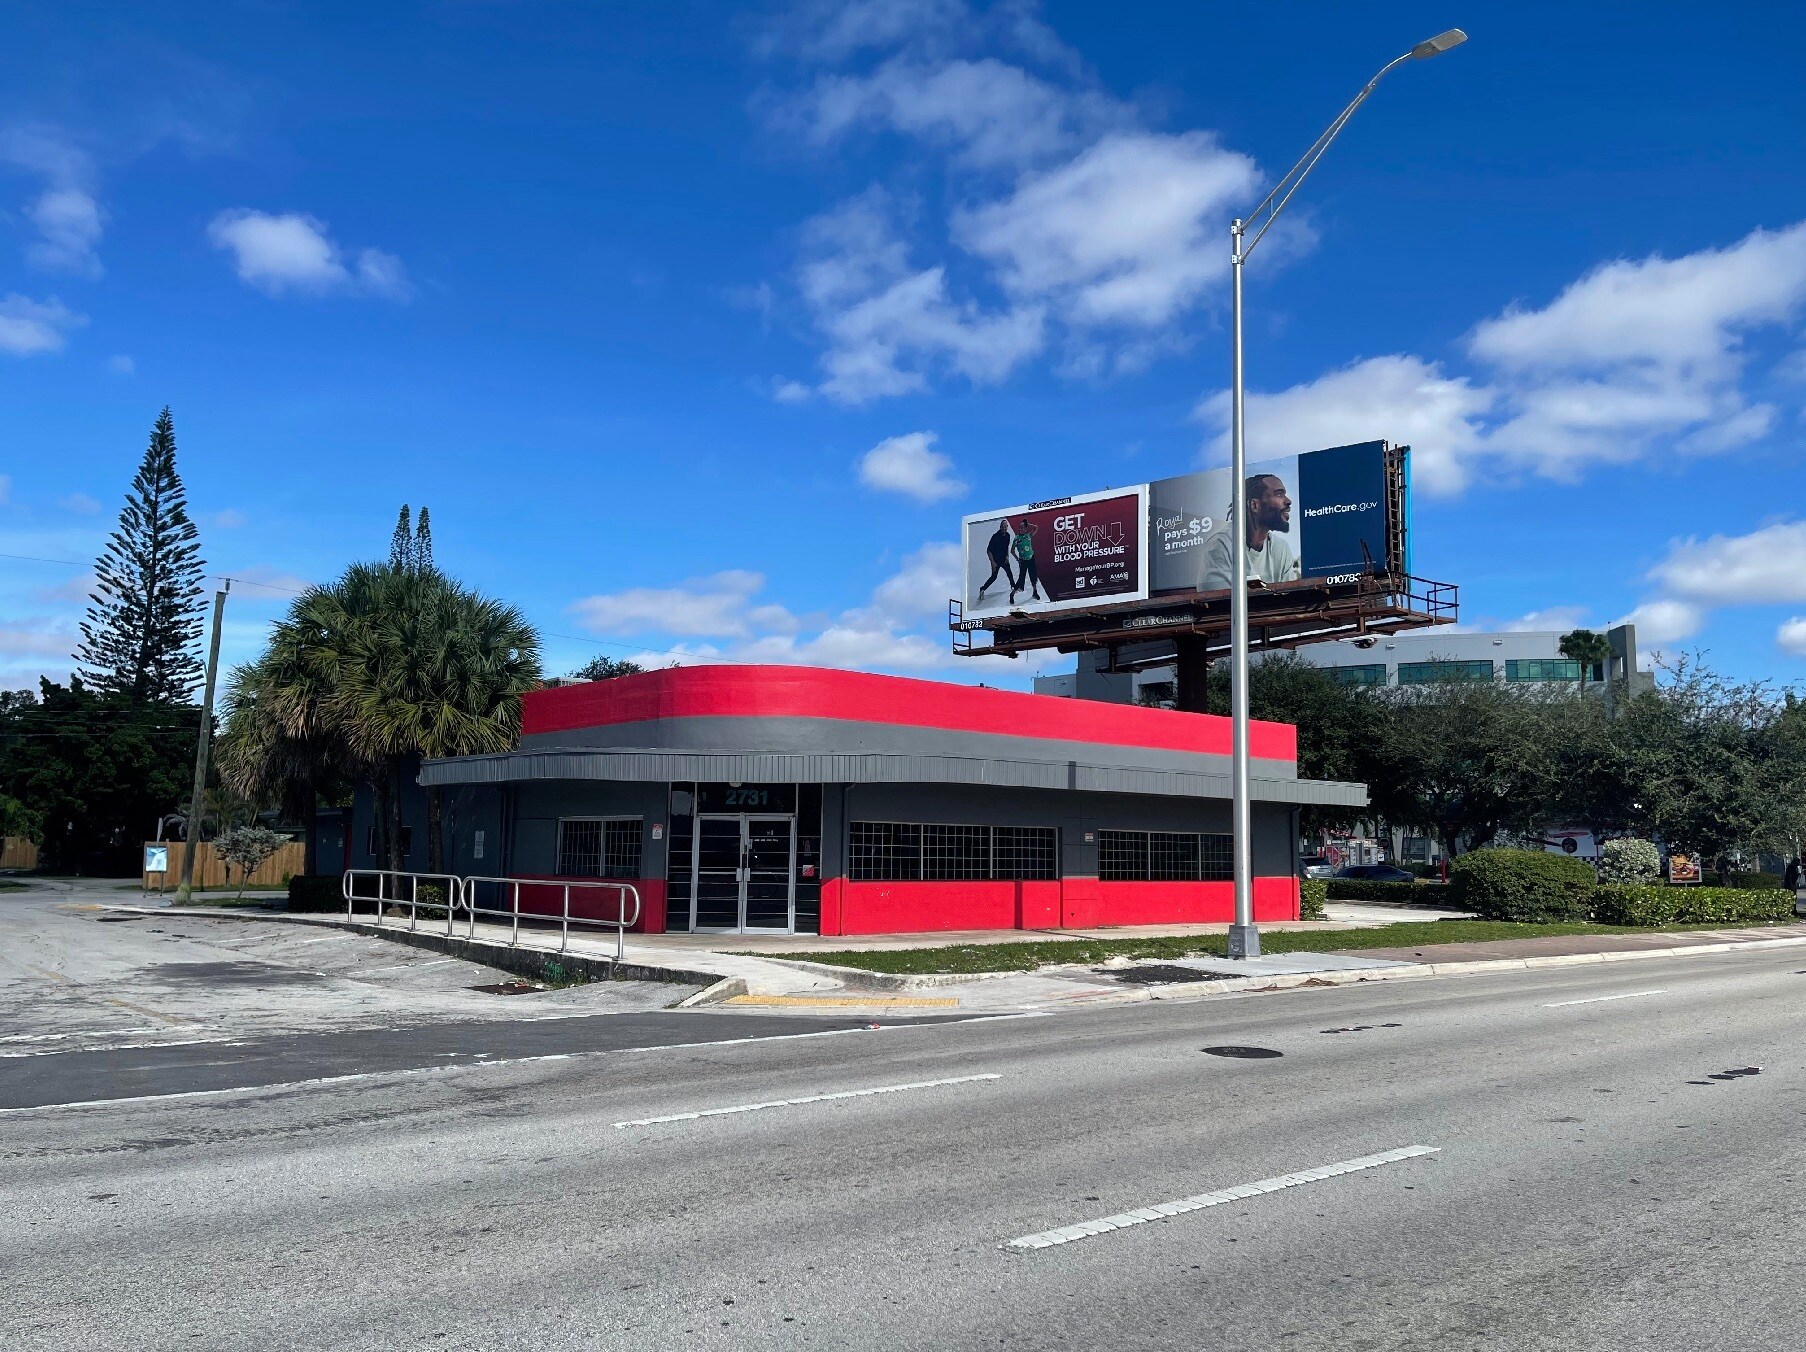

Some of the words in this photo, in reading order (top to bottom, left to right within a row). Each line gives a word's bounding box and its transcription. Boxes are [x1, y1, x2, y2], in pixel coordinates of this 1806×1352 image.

[1304, 501, 1378, 517] HealthCare.gov
[1053, 513, 1085, 531] GET
[1156, 507, 1184, 536] Royal
[1164, 528, 1187, 541] pays
[1189, 516, 1213, 535] $9
[1053, 524, 1107, 547] DOWN
[1164, 542, 1171, 550] a
[1171, 535, 1204, 549] month
[1054, 545, 1075, 554] WITH
[1076, 541, 1100, 551] YOUR
[1054, 552, 1082, 563] BLOOD
[1083, 546, 1125, 559] PRESSURE
[725, 789, 768, 805] 2731
